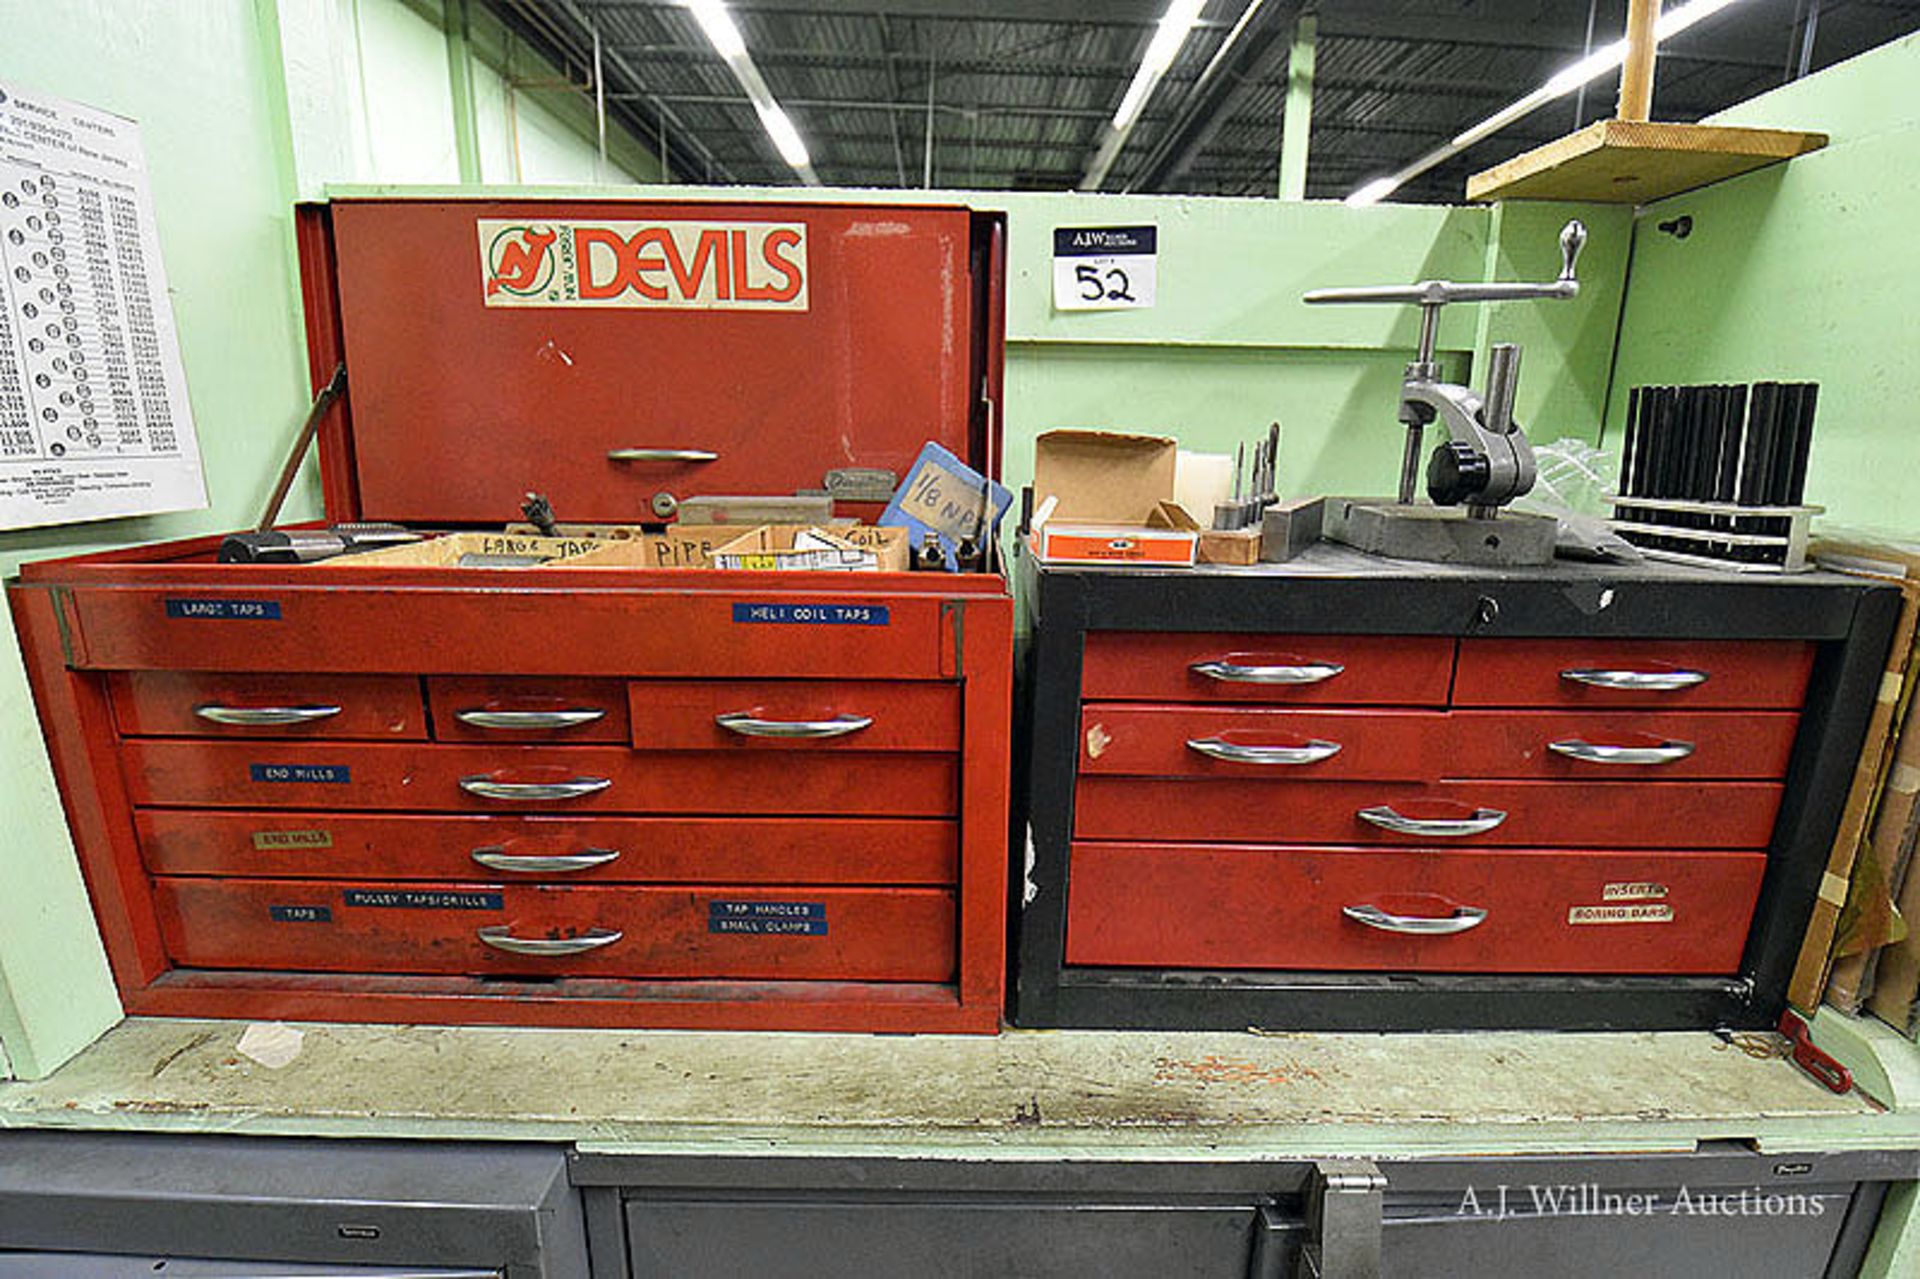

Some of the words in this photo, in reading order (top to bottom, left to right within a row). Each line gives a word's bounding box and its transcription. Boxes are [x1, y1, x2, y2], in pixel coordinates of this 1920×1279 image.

[574, 227, 802, 302] DEVILS
[1075, 265, 1136, 302] 52
[230, 603, 264, 615] TAPS
[750, 606, 785, 620] HELI
[793, 607, 827, 620] COIL
[836, 608, 870, 620] TAPS
[265, 767, 289, 779] END
[294, 769, 335, 780] MILLS
[286, 908, 316, 920] TAPS
[725, 903, 749, 914] TAP
[755, 906, 810, 916] HANDLES
[1574, 908, 1627, 920] BORING
[1631, 907, 1668, 918] BARS
[720, 920, 760, 932] SMALL
[765, 922, 811, 932] CLAMPS
